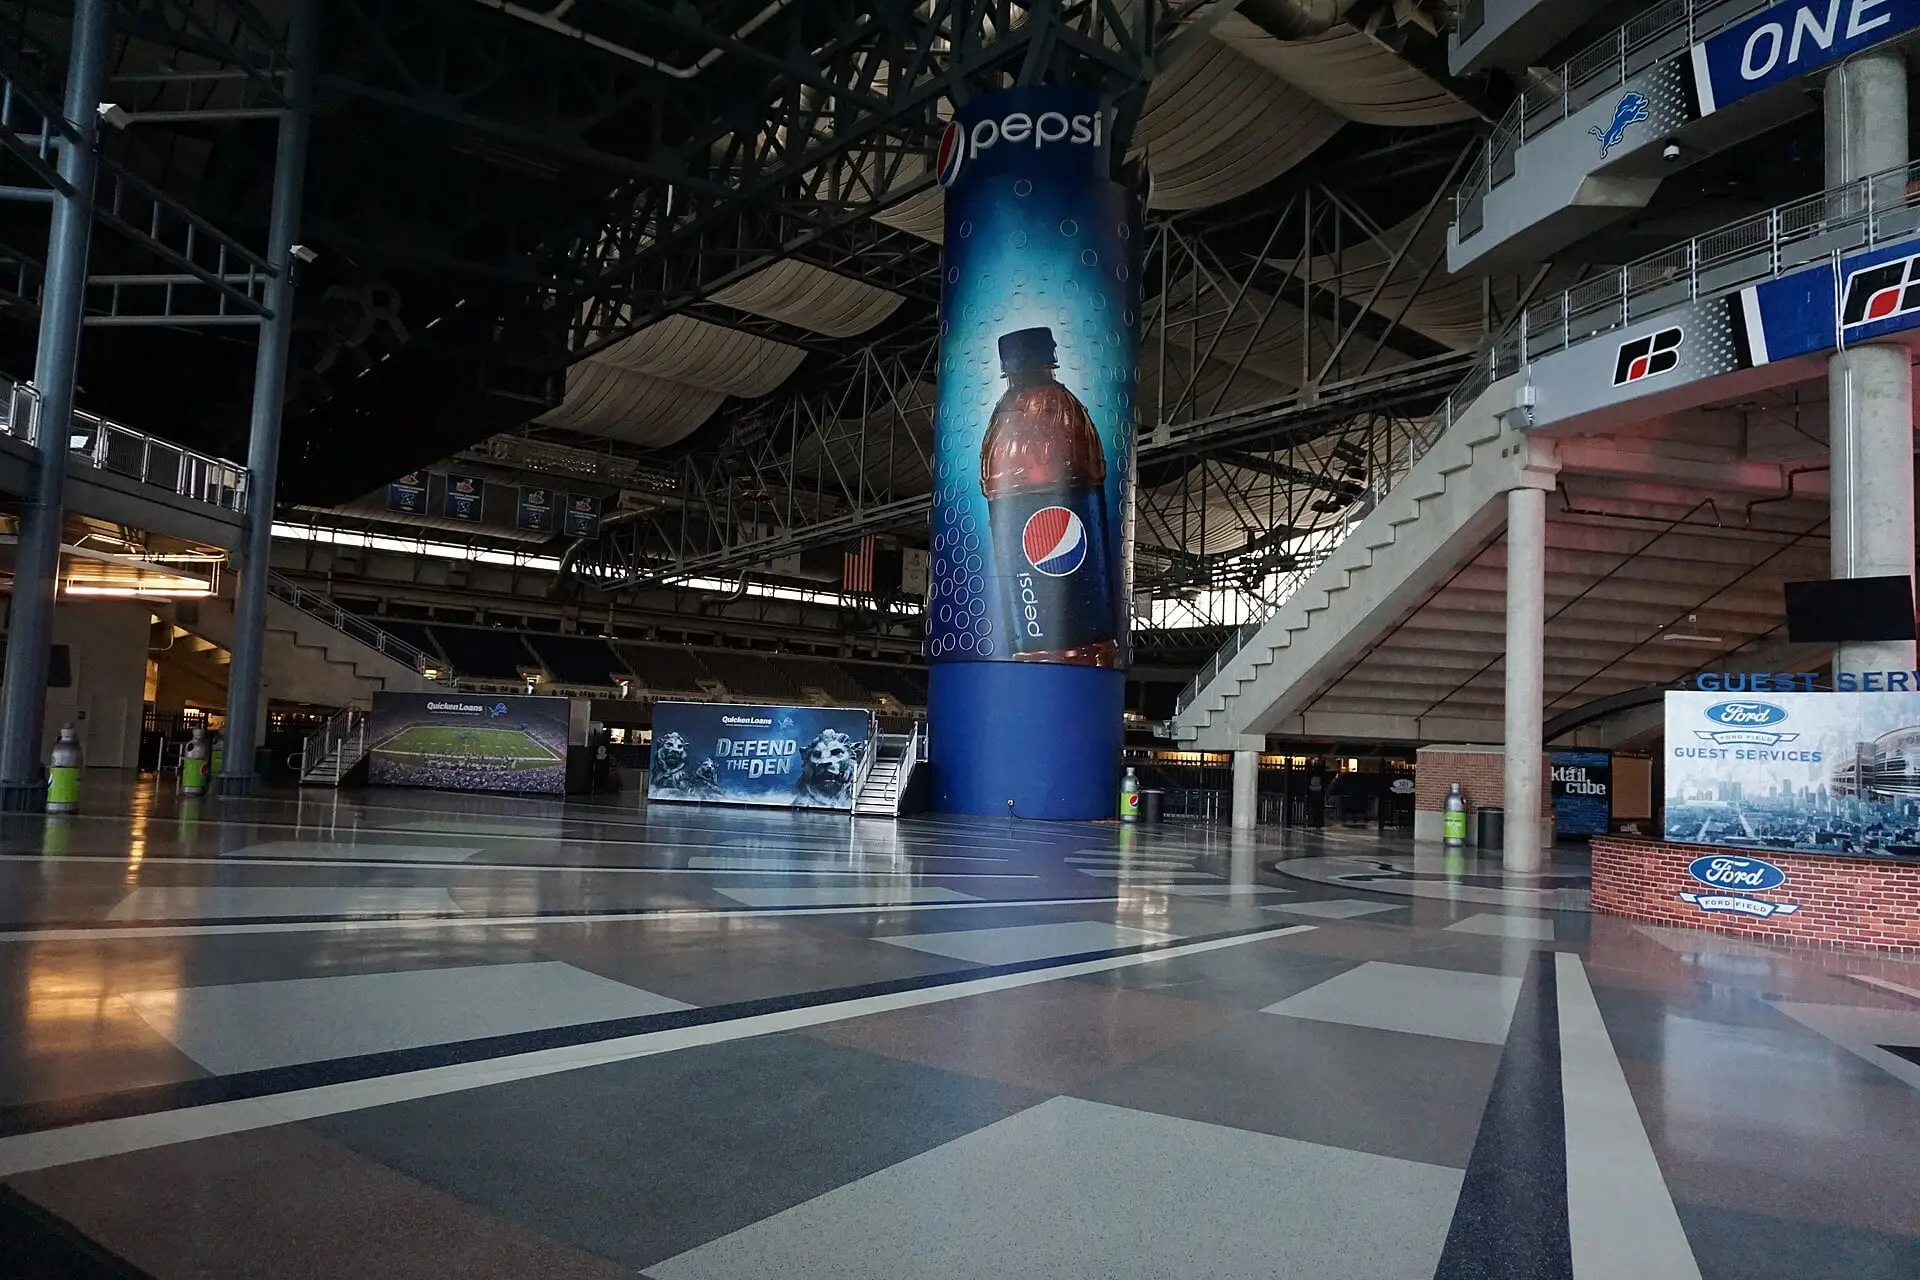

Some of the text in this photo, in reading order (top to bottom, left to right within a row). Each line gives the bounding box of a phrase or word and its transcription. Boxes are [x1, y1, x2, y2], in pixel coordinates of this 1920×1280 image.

[1740, 0, 1892, 81] ONE
[970, 111, 1103, 160] pepsi
[1017, 572, 1044, 637] pepsi
[1696, 671, 1819, 692] GUEST
[427, 702, 483, 712] Quicken Loans
[1720, 703, 1770, 722] Ford
[722, 716, 772, 725] Quicken Loans
[715, 738, 797, 757] DEFEND
[1674, 747, 1822, 763] GUEST SERVICES
[726, 758, 791, 779] THE DEN
[1551, 766, 1586, 782] ktail
[1565, 779, 1606, 794] cube
[1706, 858, 1765, 886] Ford
[1735, 901, 1767, 913] FIELD
